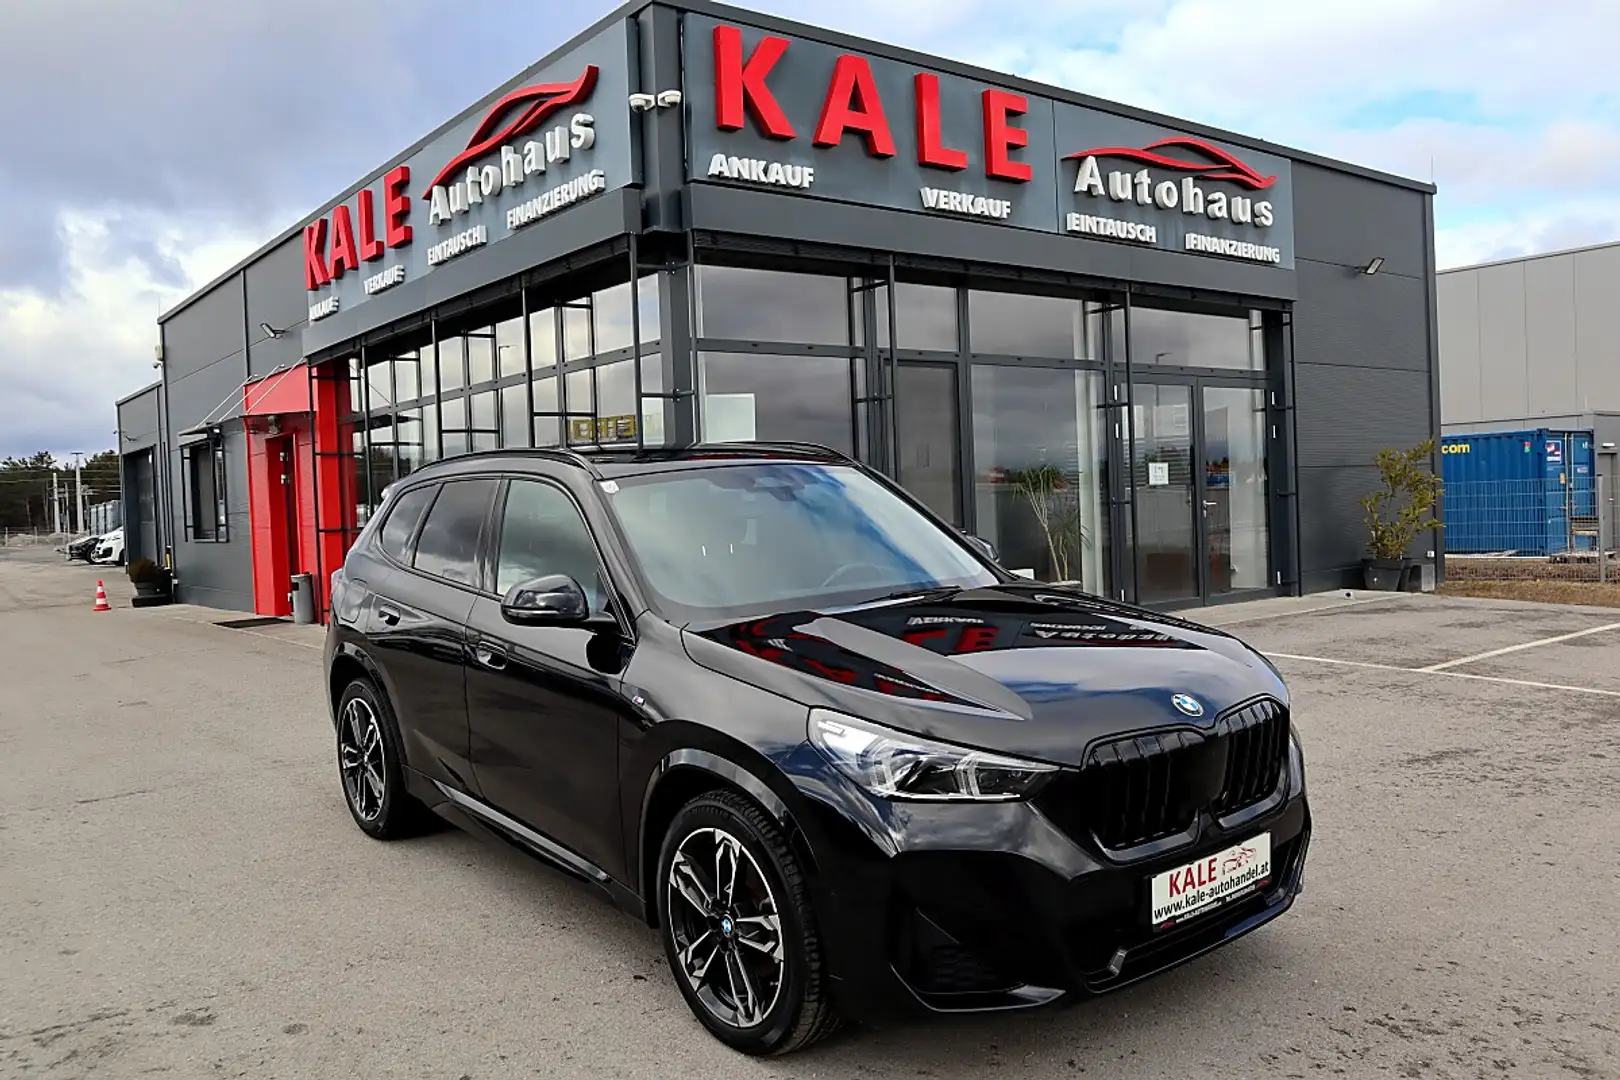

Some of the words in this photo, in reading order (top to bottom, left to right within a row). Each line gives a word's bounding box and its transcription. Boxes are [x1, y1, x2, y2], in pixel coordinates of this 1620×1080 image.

[712, 24, 1032, 183] KALE
[429, 113, 596, 226] Autohaus
[707, 153, 815, 189] ANKAUF
[1074, 155, 1274, 227] Autohaus
[506, 169, 606, 230] FINANZIERUNG
[920, 187, 1012, 220] VERKAUF
[303, 165, 413, 291] KALE
[427, 225, 488, 266] EINTAUSCH
[1066, 212, 1157, 243] EINTAUSCH
[1185, 232, 1281, 264] FINANZIERUNG
[1153, 860, 1269, 920] www.kale-autohandel.at
[1168, 857, 1218, 898] KALE
